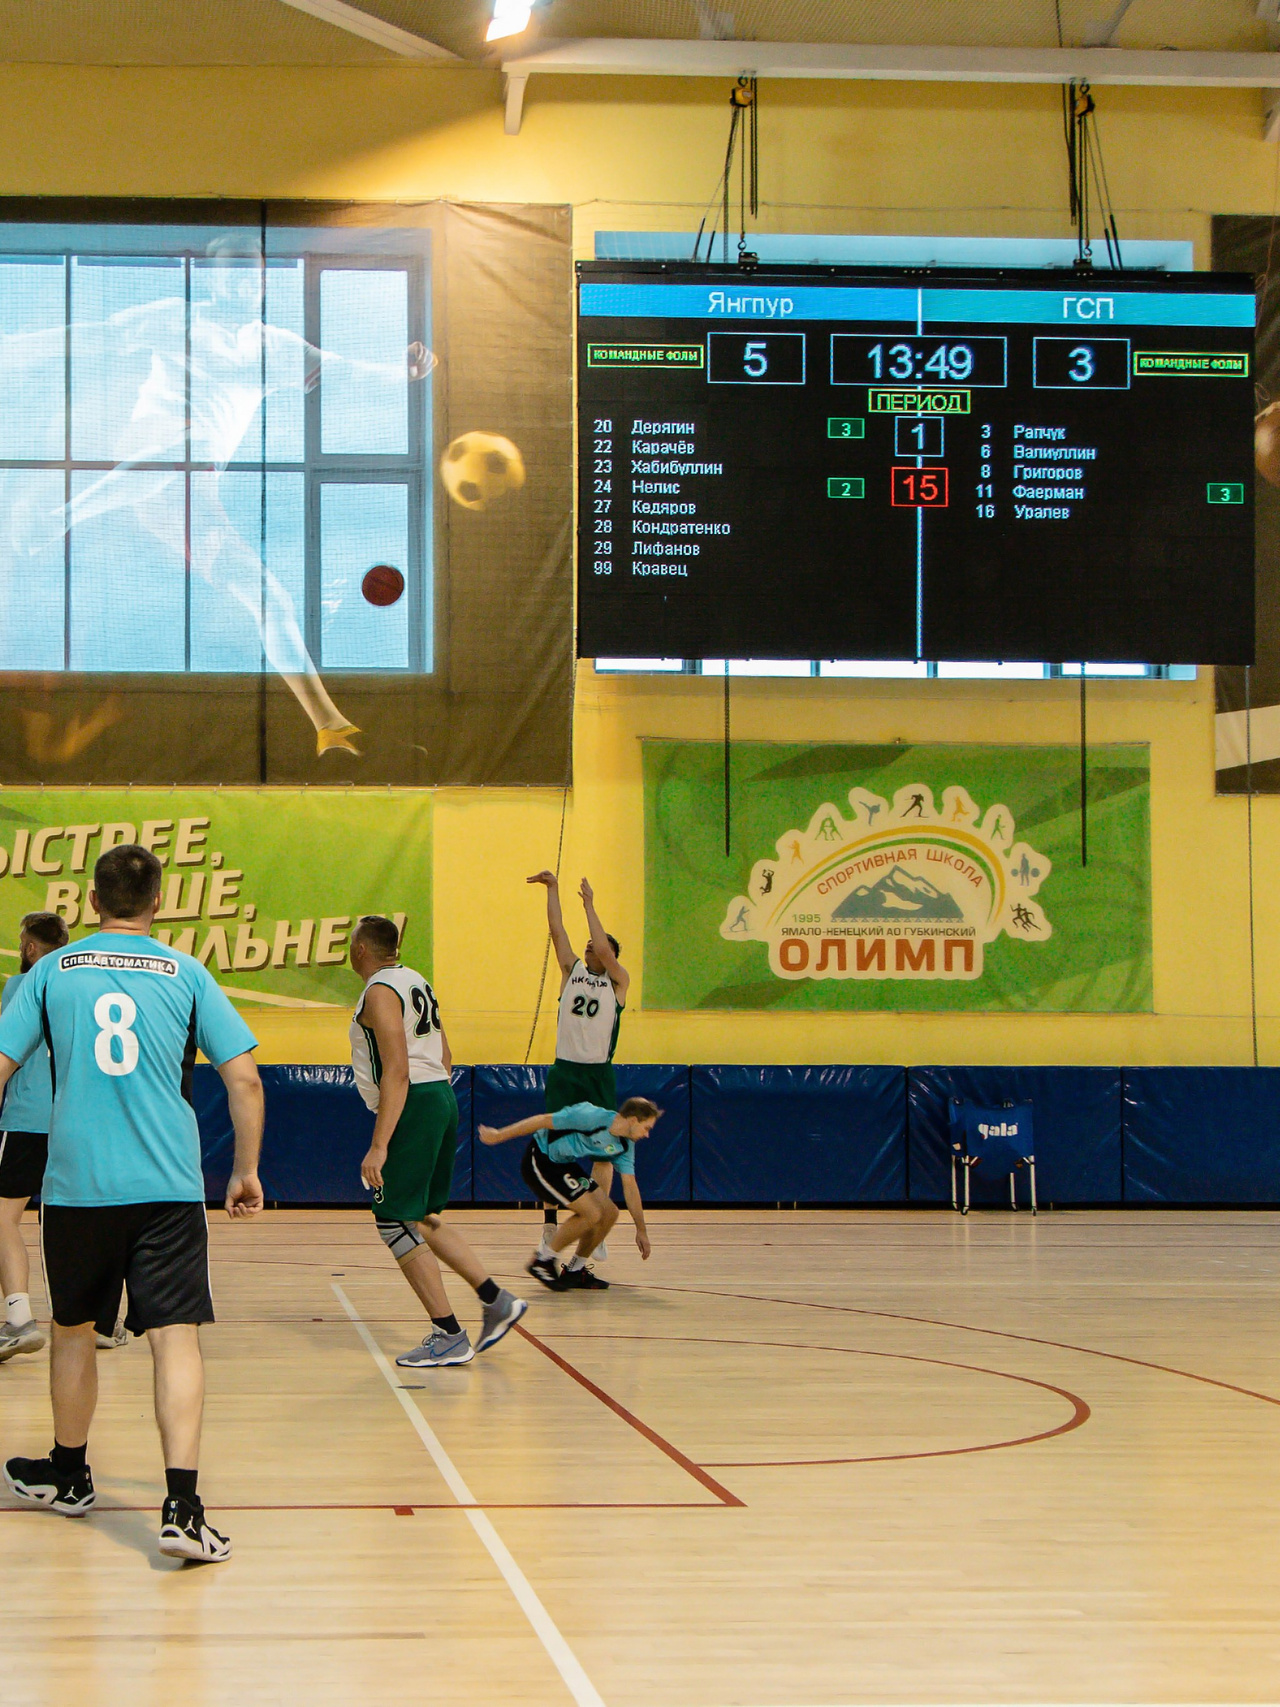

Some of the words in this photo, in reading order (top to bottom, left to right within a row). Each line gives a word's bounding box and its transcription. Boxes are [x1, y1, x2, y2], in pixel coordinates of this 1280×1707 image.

[708, 291, 794, 318] Янгпур
[1062, 297, 1114, 319] ГСП
[593, 349, 664, 361] КОМАНДНЫЕ
[666, 351, 698, 361] ФОЛЫ
[743, 342, 768, 377] 5
[868, 343, 973, 380] 13:49
[1069, 347, 1095, 382] 3
[1140, 358, 1209, 370] КОМАНДНЫЕ
[1210, 359, 1243, 370] ФОЛЫ
[876, 394, 962, 412] ПЕРИОД
[593, 419, 613, 433] 20
[631, 420, 695, 435] Дерягин
[841, 423, 851, 437] 3
[981, 424, 991, 439] 3
[1013, 425, 1067, 441] Рапчук
[911, 423, 925, 450] 1
[593, 439, 613, 454] 22
[632, 440, 695, 455] Карачёв
[980, 444, 991, 459] 6
[1013, 445, 1097, 461] Валиуллин
[593, 459, 613, 474] 23
[631, 460, 723, 476] Хабибуллин
[980, 464, 991, 479] 8
[1013, 465, 1084, 480] Григоров
[593, 479, 613, 494] 24
[632, 480, 681, 494] Нелис
[841, 483, 851, 496] 2
[902, 475, 939, 501] 15
[975, 484, 993, 498] 11
[1012, 485, 1085, 500] Фаерман
[1220, 487, 1231, 501] 3
[593, 499, 613, 513] 27
[632, 500, 696, 515] Кедяров
[975, 504, 996, 518] 16
[1014, 505, 1070, 520] Уралев
[593, 520, 613, 533] 28
[632, 520, 731, 535] Кондратенко
[593, 541, 613, 554] 29
[631, 541, 700, 556] Лифанов
[593, 561, 613, 575] 99
[632, 561, 688, 577] Кравец
[816, 848, 918, 895] СПОРТИВНАЯ
[925, 848, 984, 888] ШКОЛА
[44, 869, 257, 929] ВШЕ,
[791, 913, 821, 923] 1995
[781, 926, 884, 937] ЯМАЛО-НЕНЕЦКИЙ
[886, 927, 901, 936] АО
[904, 926, 976, 937] ГУБКИНСКИЙ
[63, 954, 174, 973] СПЕЦАВТОМАТИКА
[779, 938, 974, 972] ОЛИМП
[571, 995, 600, 1018] 20
[93, 992, 140, 1077] 8
[978, 1122, 1018, 1140] gala
[563, 1173, 579, 1190] 6
